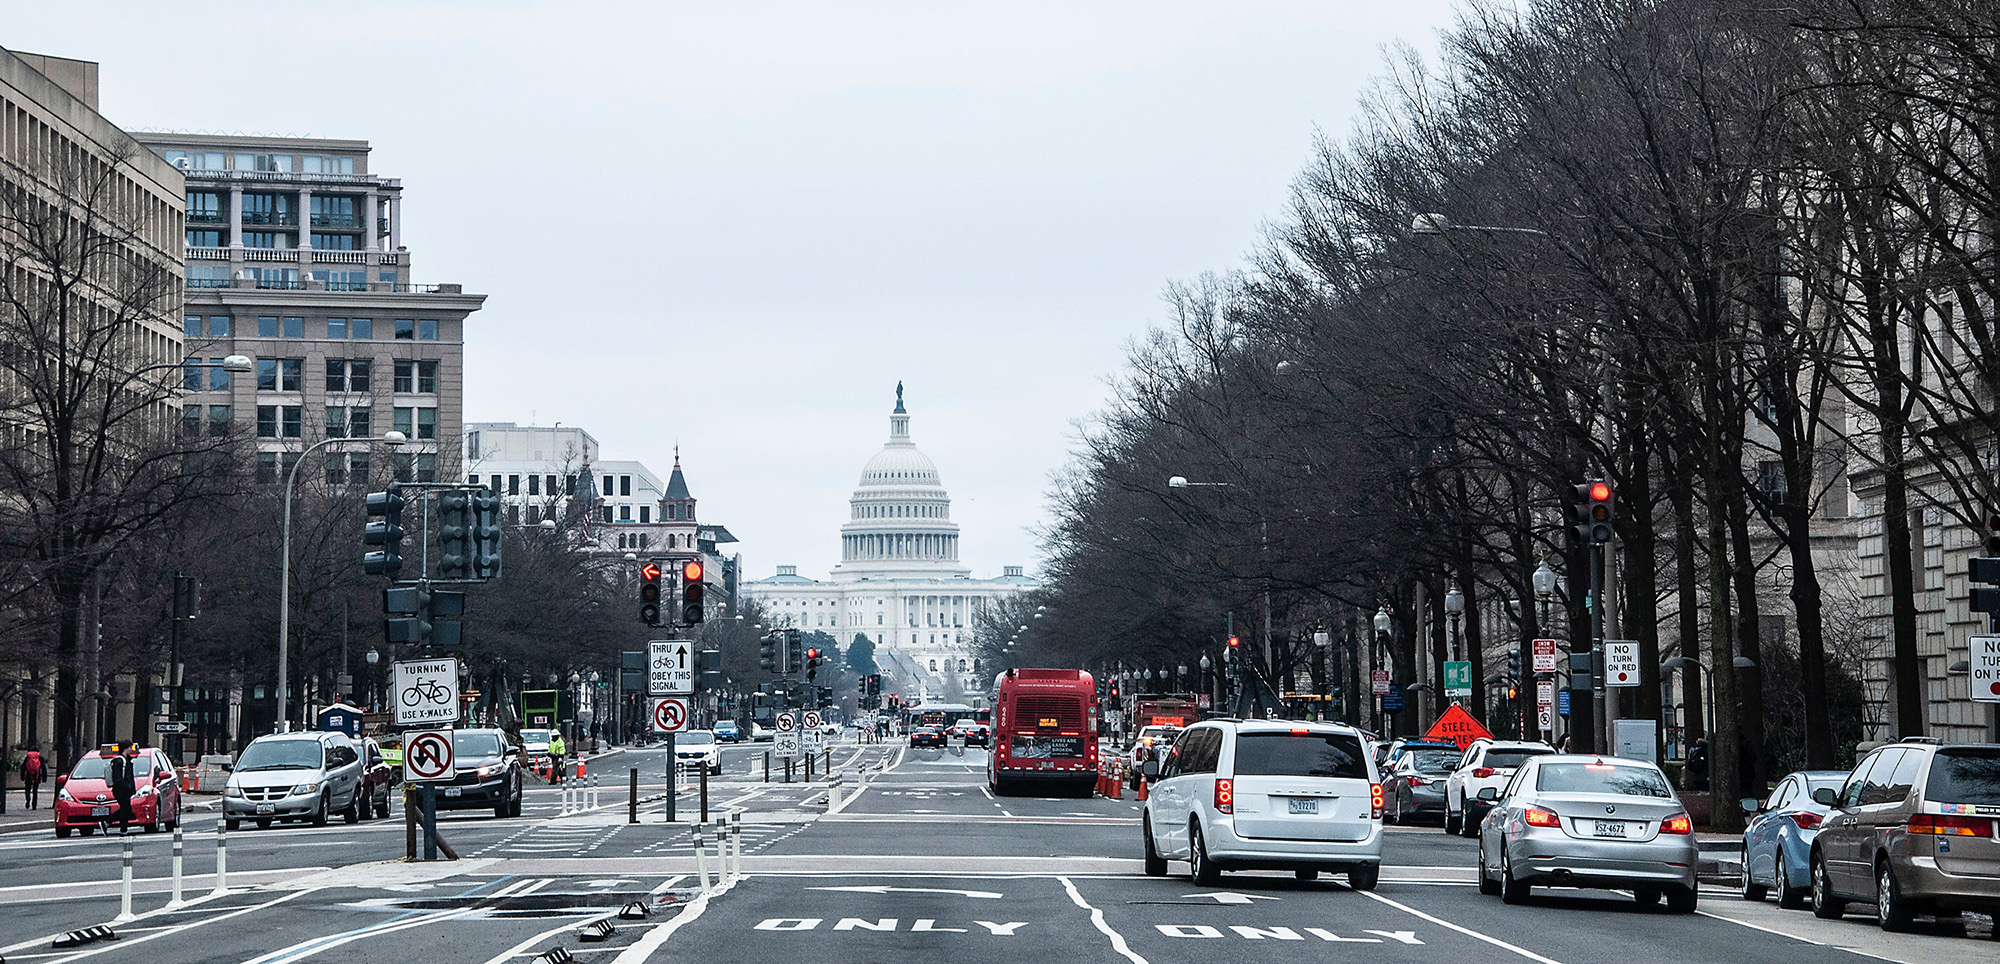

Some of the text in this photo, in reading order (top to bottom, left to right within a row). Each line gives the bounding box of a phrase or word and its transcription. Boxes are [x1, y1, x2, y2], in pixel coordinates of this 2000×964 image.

[652, 644, 672, 653] THRU
[1614, 645, 1629, 654] NO
[1612, 655, 1632, 663] TURN
[405, 664, 447, 674] TURNING
[1974, 669, 1991, 679] ON
[652, 671, 691, 680] OBEY THIS
[652, 682, 678, 690] SIGNAL
[402, 708, 453, 719] USE X-WALKS
[1441, 722, 1472, 732] STEEL
[753, 918, 1030, 936] ONLY
[1154, 925, 1426, 944] ONLY
